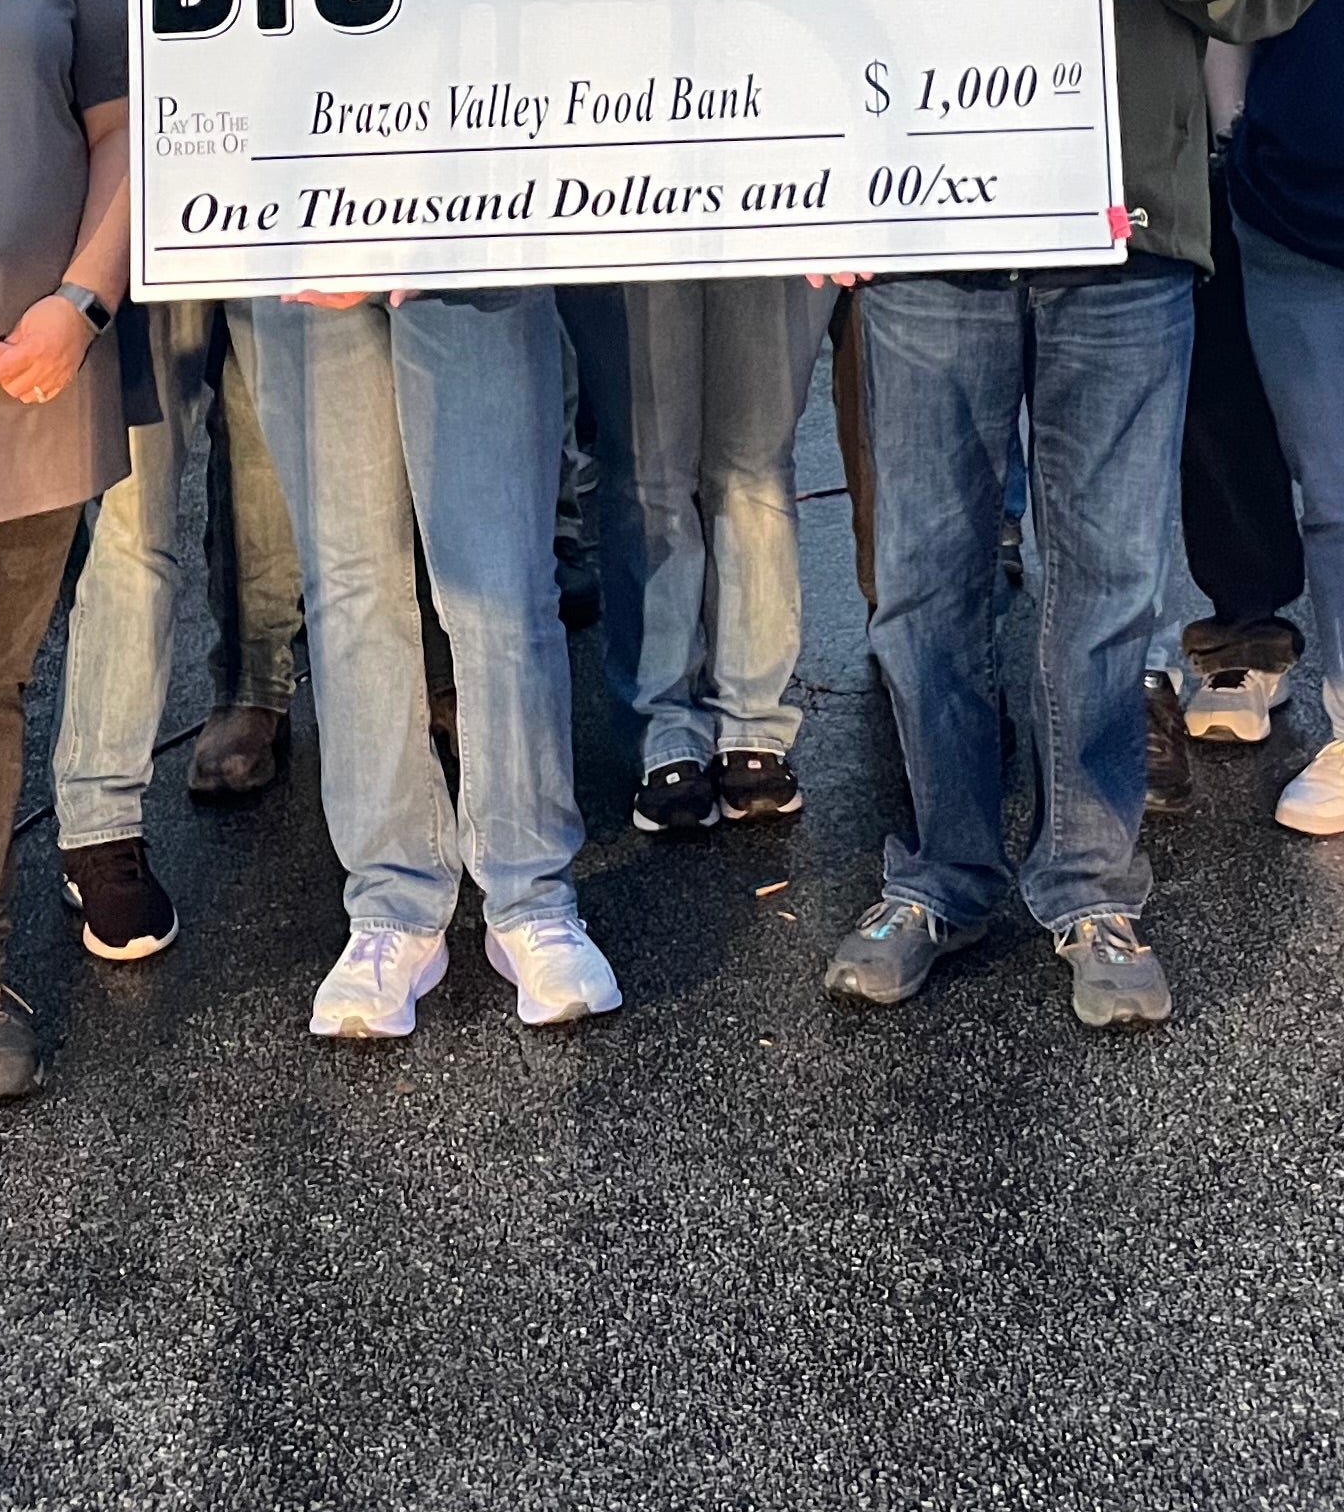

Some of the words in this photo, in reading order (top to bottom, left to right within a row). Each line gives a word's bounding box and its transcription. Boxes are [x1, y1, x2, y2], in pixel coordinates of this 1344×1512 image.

[308, 90, 430, 138] Brazos
[447, 82, 550, 139] Valley
[564, 77, 656, 126] Food
[668, 73, 763, 122] Bank
[864, 58, 891, 118] $
[913, 64, 1038, 119] 1,000
[1052, 62, 1083, 87] 00
[181, 193, 280, 234] One
[297, 179, 536, 229] Thousand
[549, 175, 724, 219] Dollars
[740, 168, 831, 212] and
[868, 163, 998, 208] 00/xx
